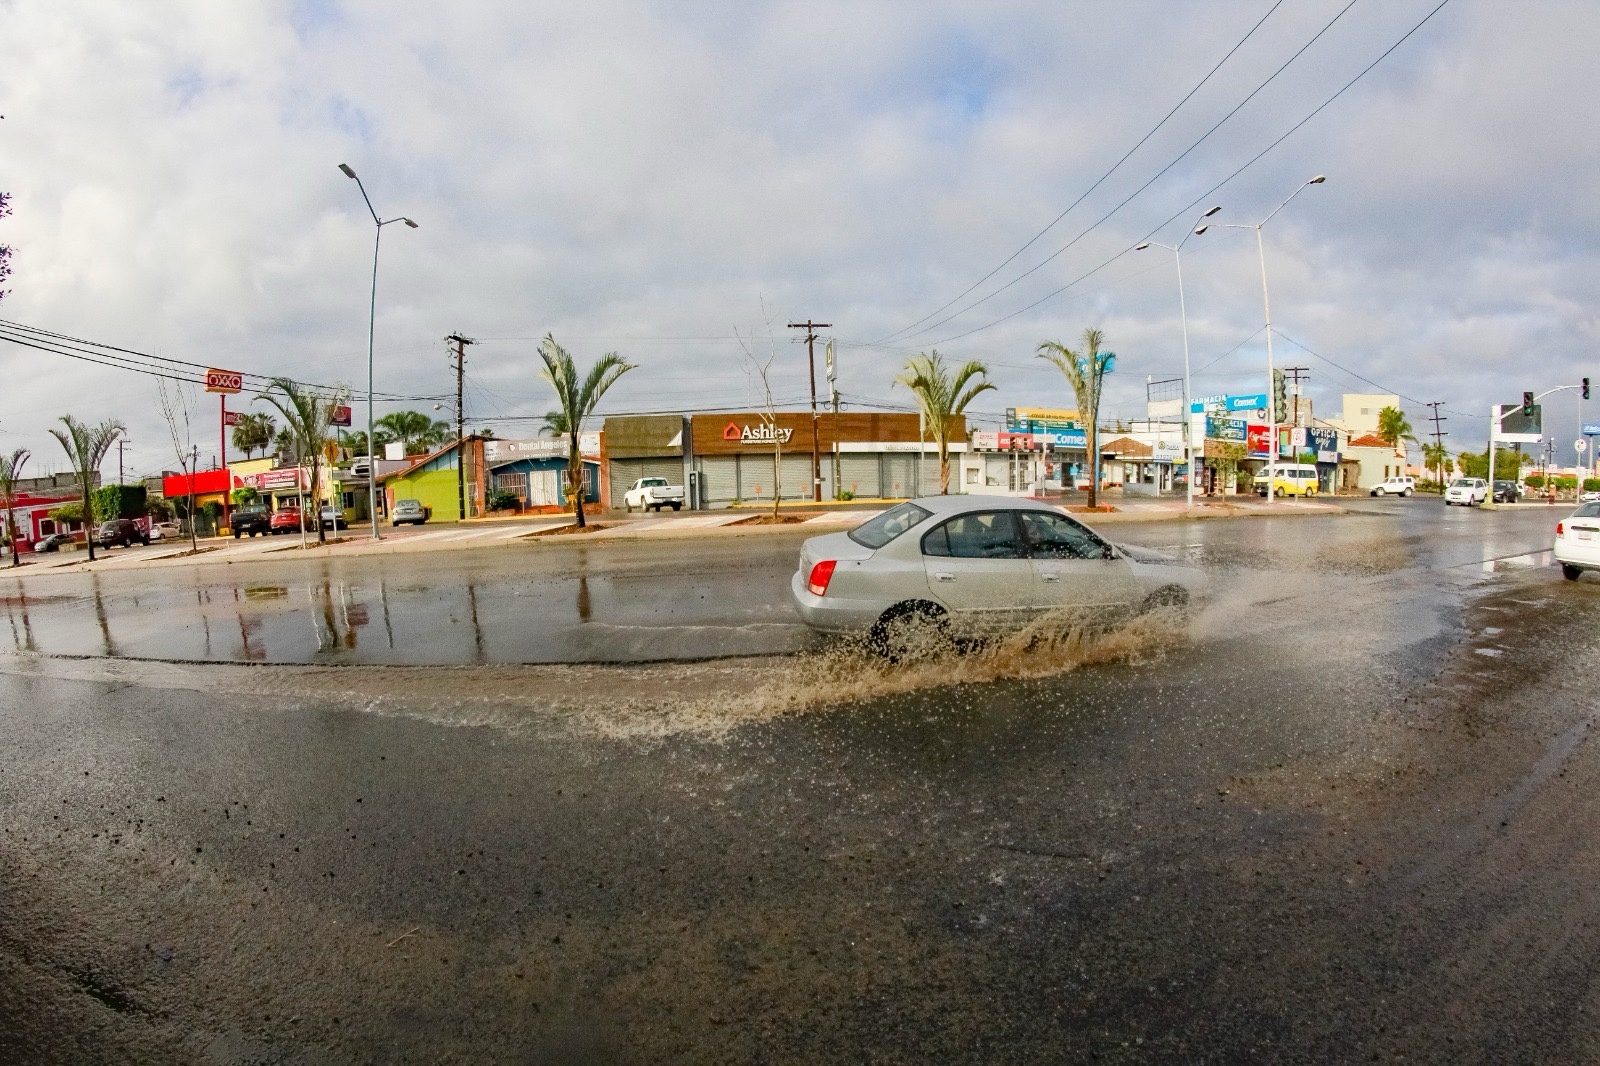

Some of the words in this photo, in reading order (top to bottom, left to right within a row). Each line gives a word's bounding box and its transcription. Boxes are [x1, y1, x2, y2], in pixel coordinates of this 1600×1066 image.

[208, 374, 241, 389] OXXO
[1191, 395, 1226, 405] FARMACIA
[1234, 396, 1258, 406] Comex
[741, 424, 793, 442] Ashley
[519, 441, 540, 450] Dental
